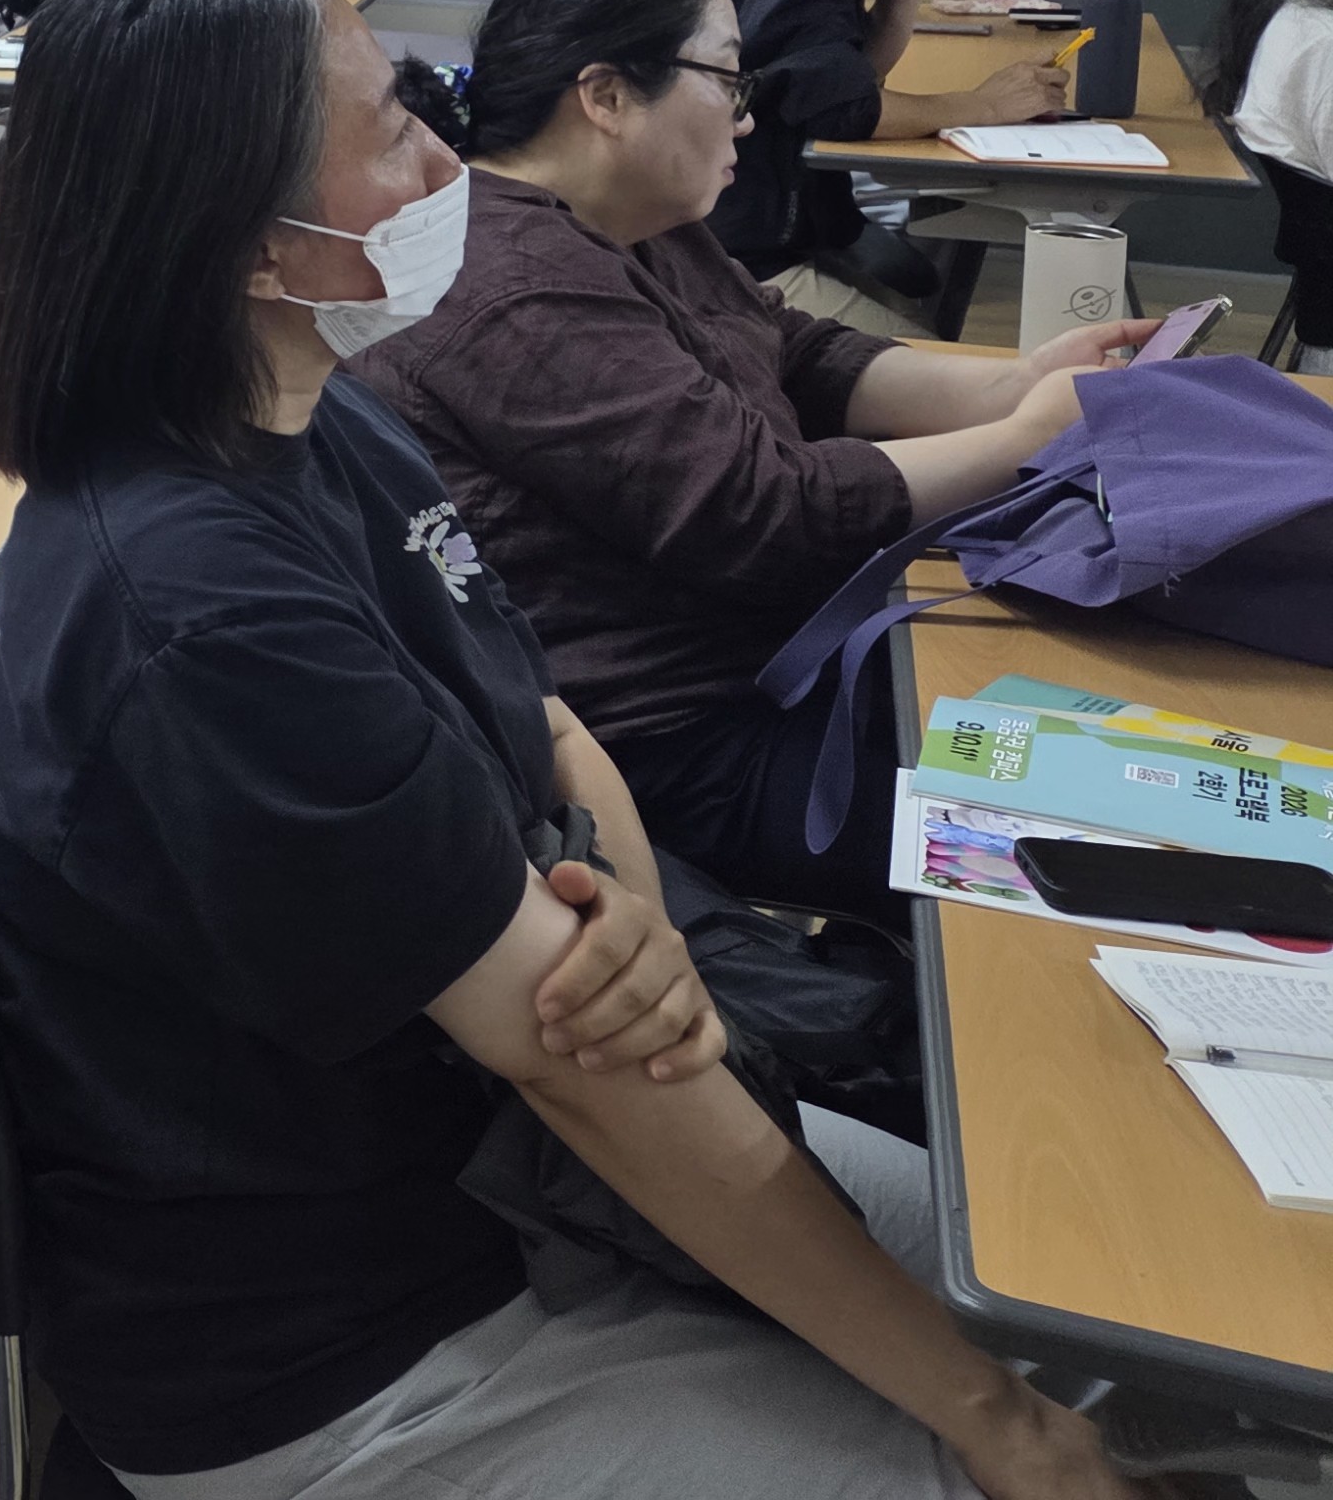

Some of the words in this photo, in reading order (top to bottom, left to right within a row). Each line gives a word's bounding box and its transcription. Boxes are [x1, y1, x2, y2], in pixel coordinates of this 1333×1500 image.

[995, 717, 1030, 750] 동남권
[989, 748, 1023, 781] 캠퍼스
[1192, 770, 1228, 803] 2학기
[1234, 767, 1271, 823] 프로그램북
[1280, 785, 1309, 818] 2026
